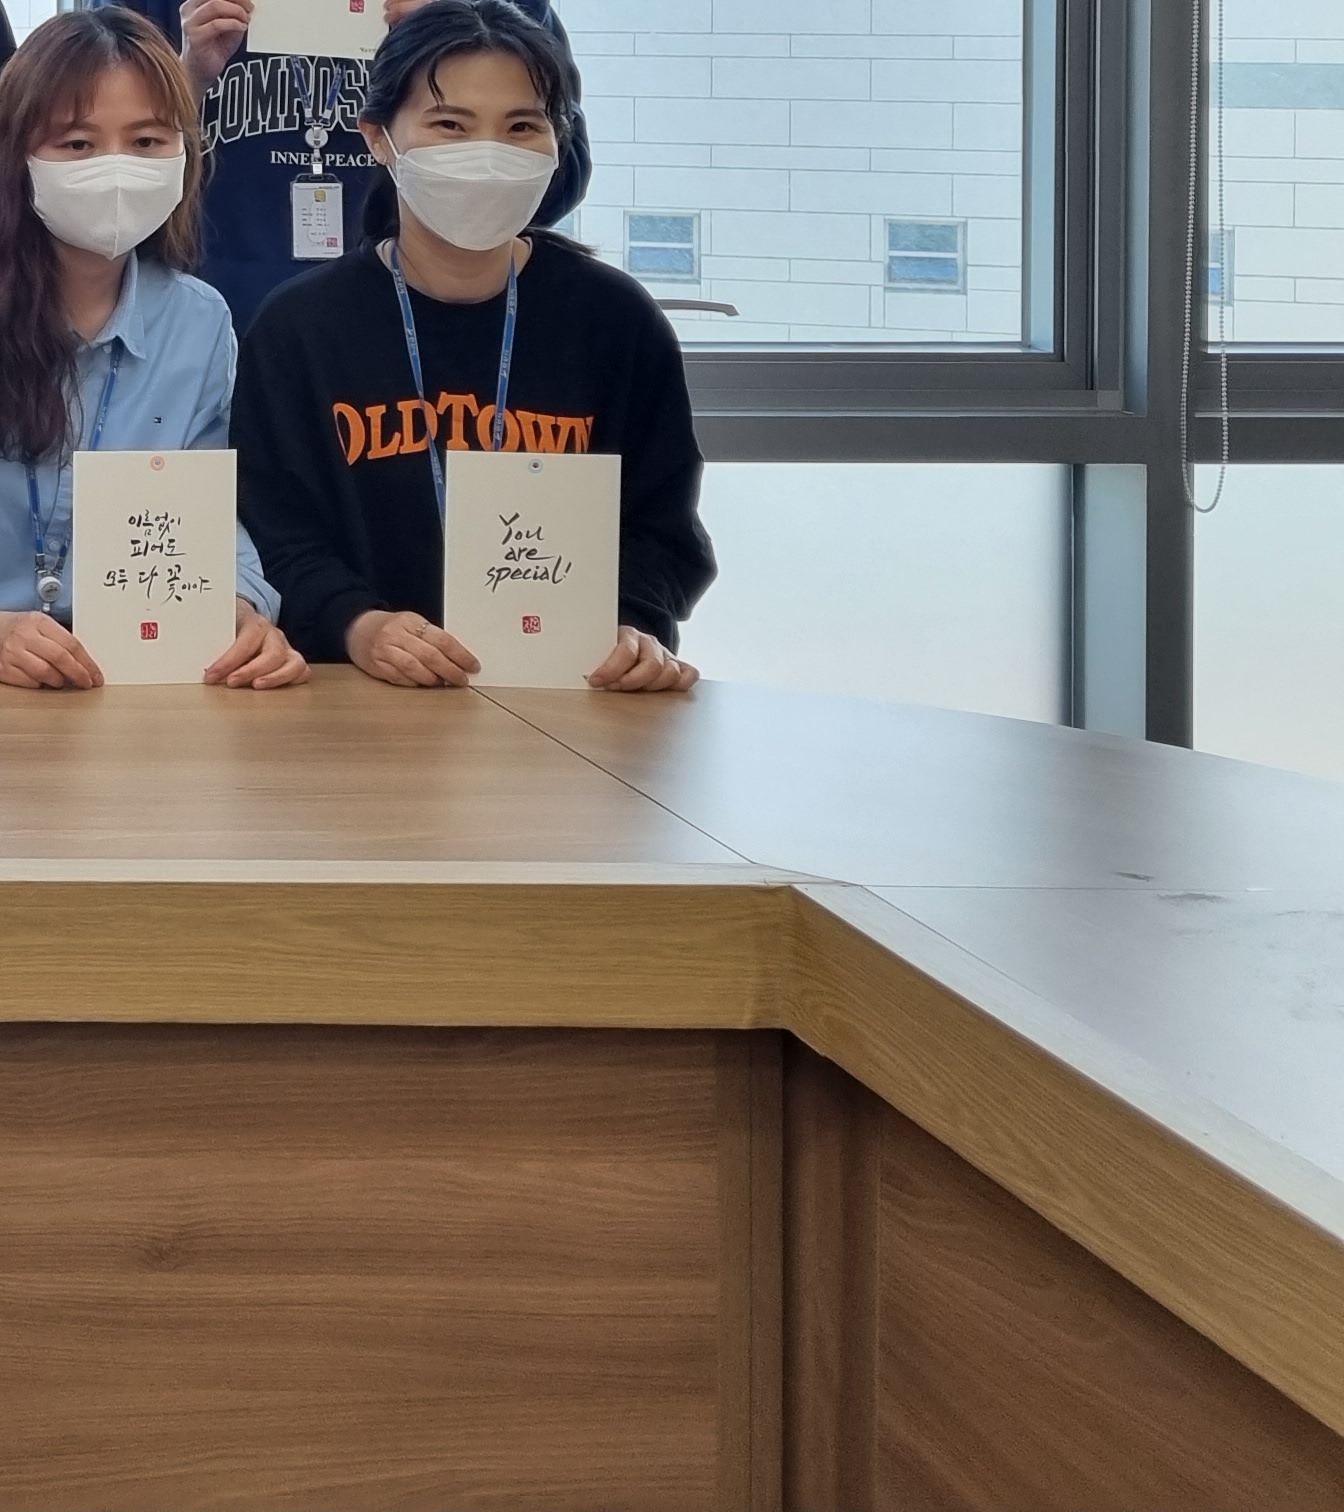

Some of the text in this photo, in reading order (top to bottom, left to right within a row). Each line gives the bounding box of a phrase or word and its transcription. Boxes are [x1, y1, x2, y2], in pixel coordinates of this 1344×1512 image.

[200, 55, 374, 156] COMPOS
[270, 150, 378, 167] INNE PEACE
[127, 508, 182, 541] 이름없이
[498, 511, 545, 546] You
[129, 538, 187, 558] 피어도
[504, 545, 556, 563] are
[138, 564, 159, 600] 다
[484, 554, 573, 594] special!
